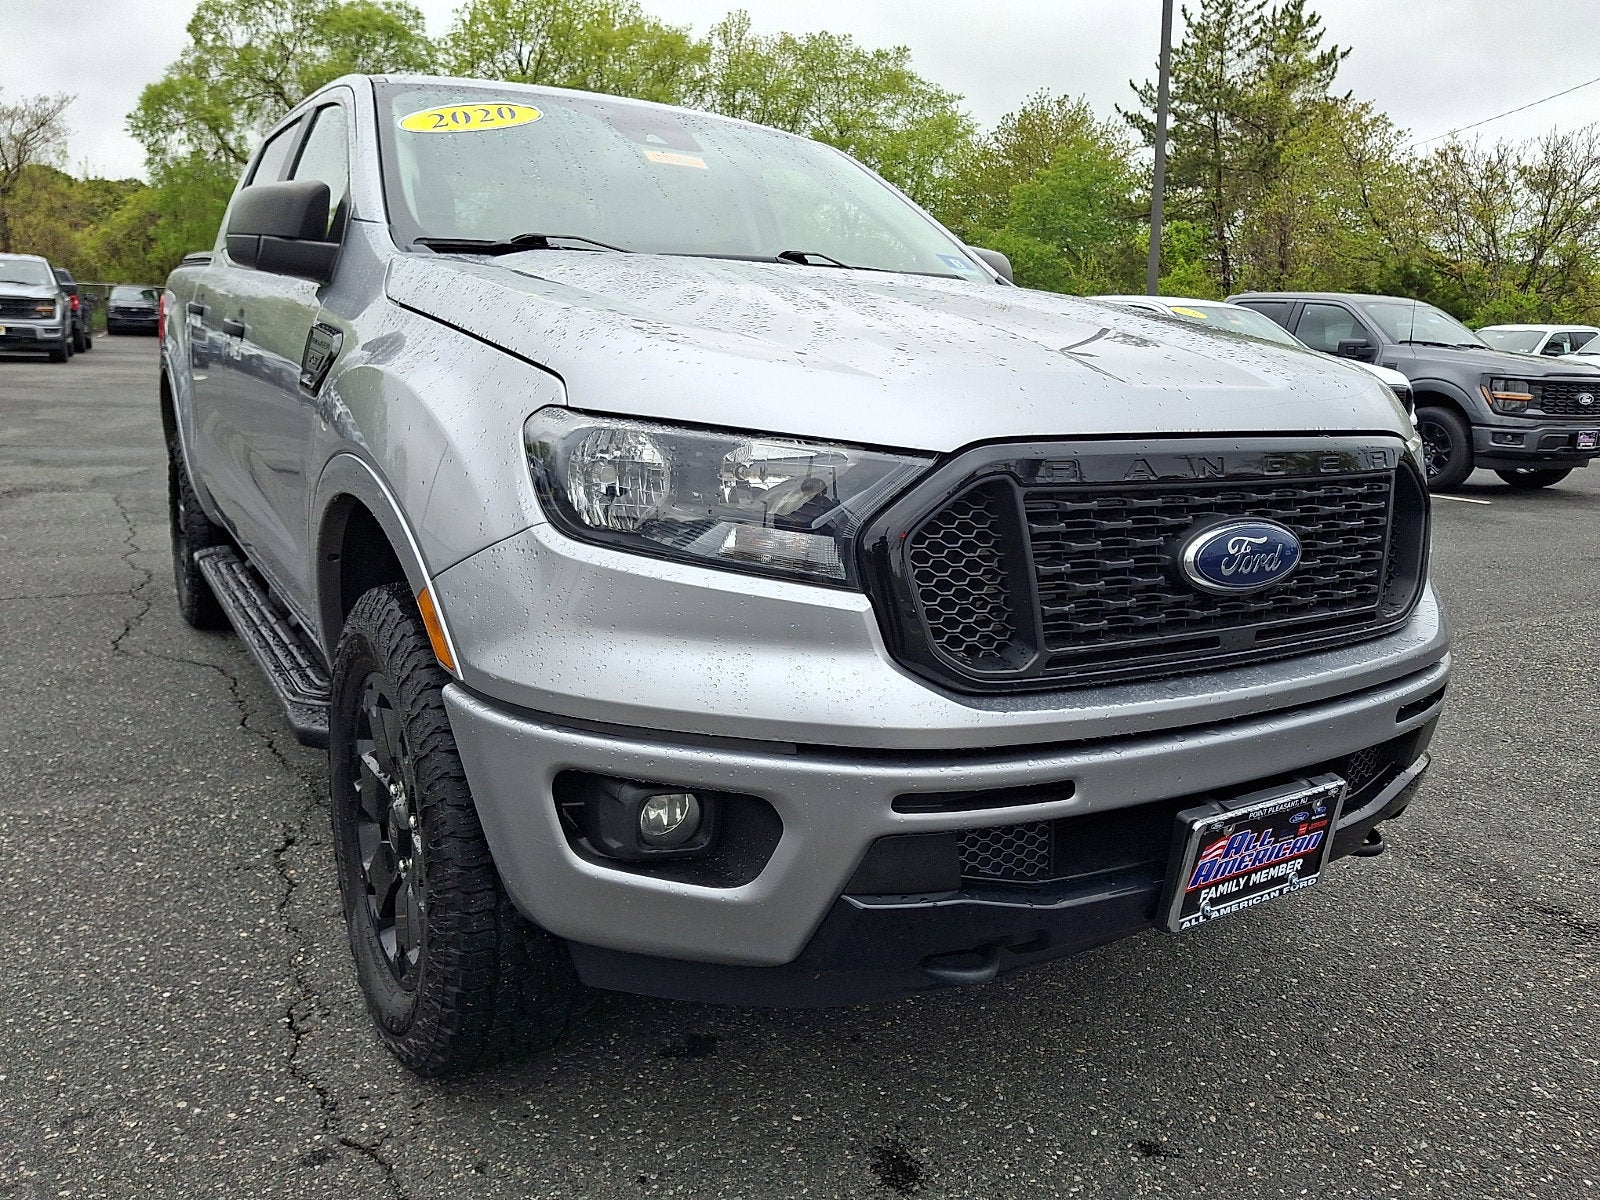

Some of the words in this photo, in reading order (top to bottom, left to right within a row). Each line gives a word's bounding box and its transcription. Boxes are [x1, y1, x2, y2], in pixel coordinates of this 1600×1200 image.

[427, 107, 516, 129] 2020
[1046, 449, 1396, 482] RANGER
[1221, 536, 1283, 576] Ford
[1249, 809, 1267, 820] POINT
[1200, 876, 1247, 902] FAMILY
[1250, 858, 1303, 886] MEMBER
[1181, 915, 1207, 929] ALL
[1210, 890, 1279, 919] AMERICAN
[1282, 878, 1317, 894] FORD
